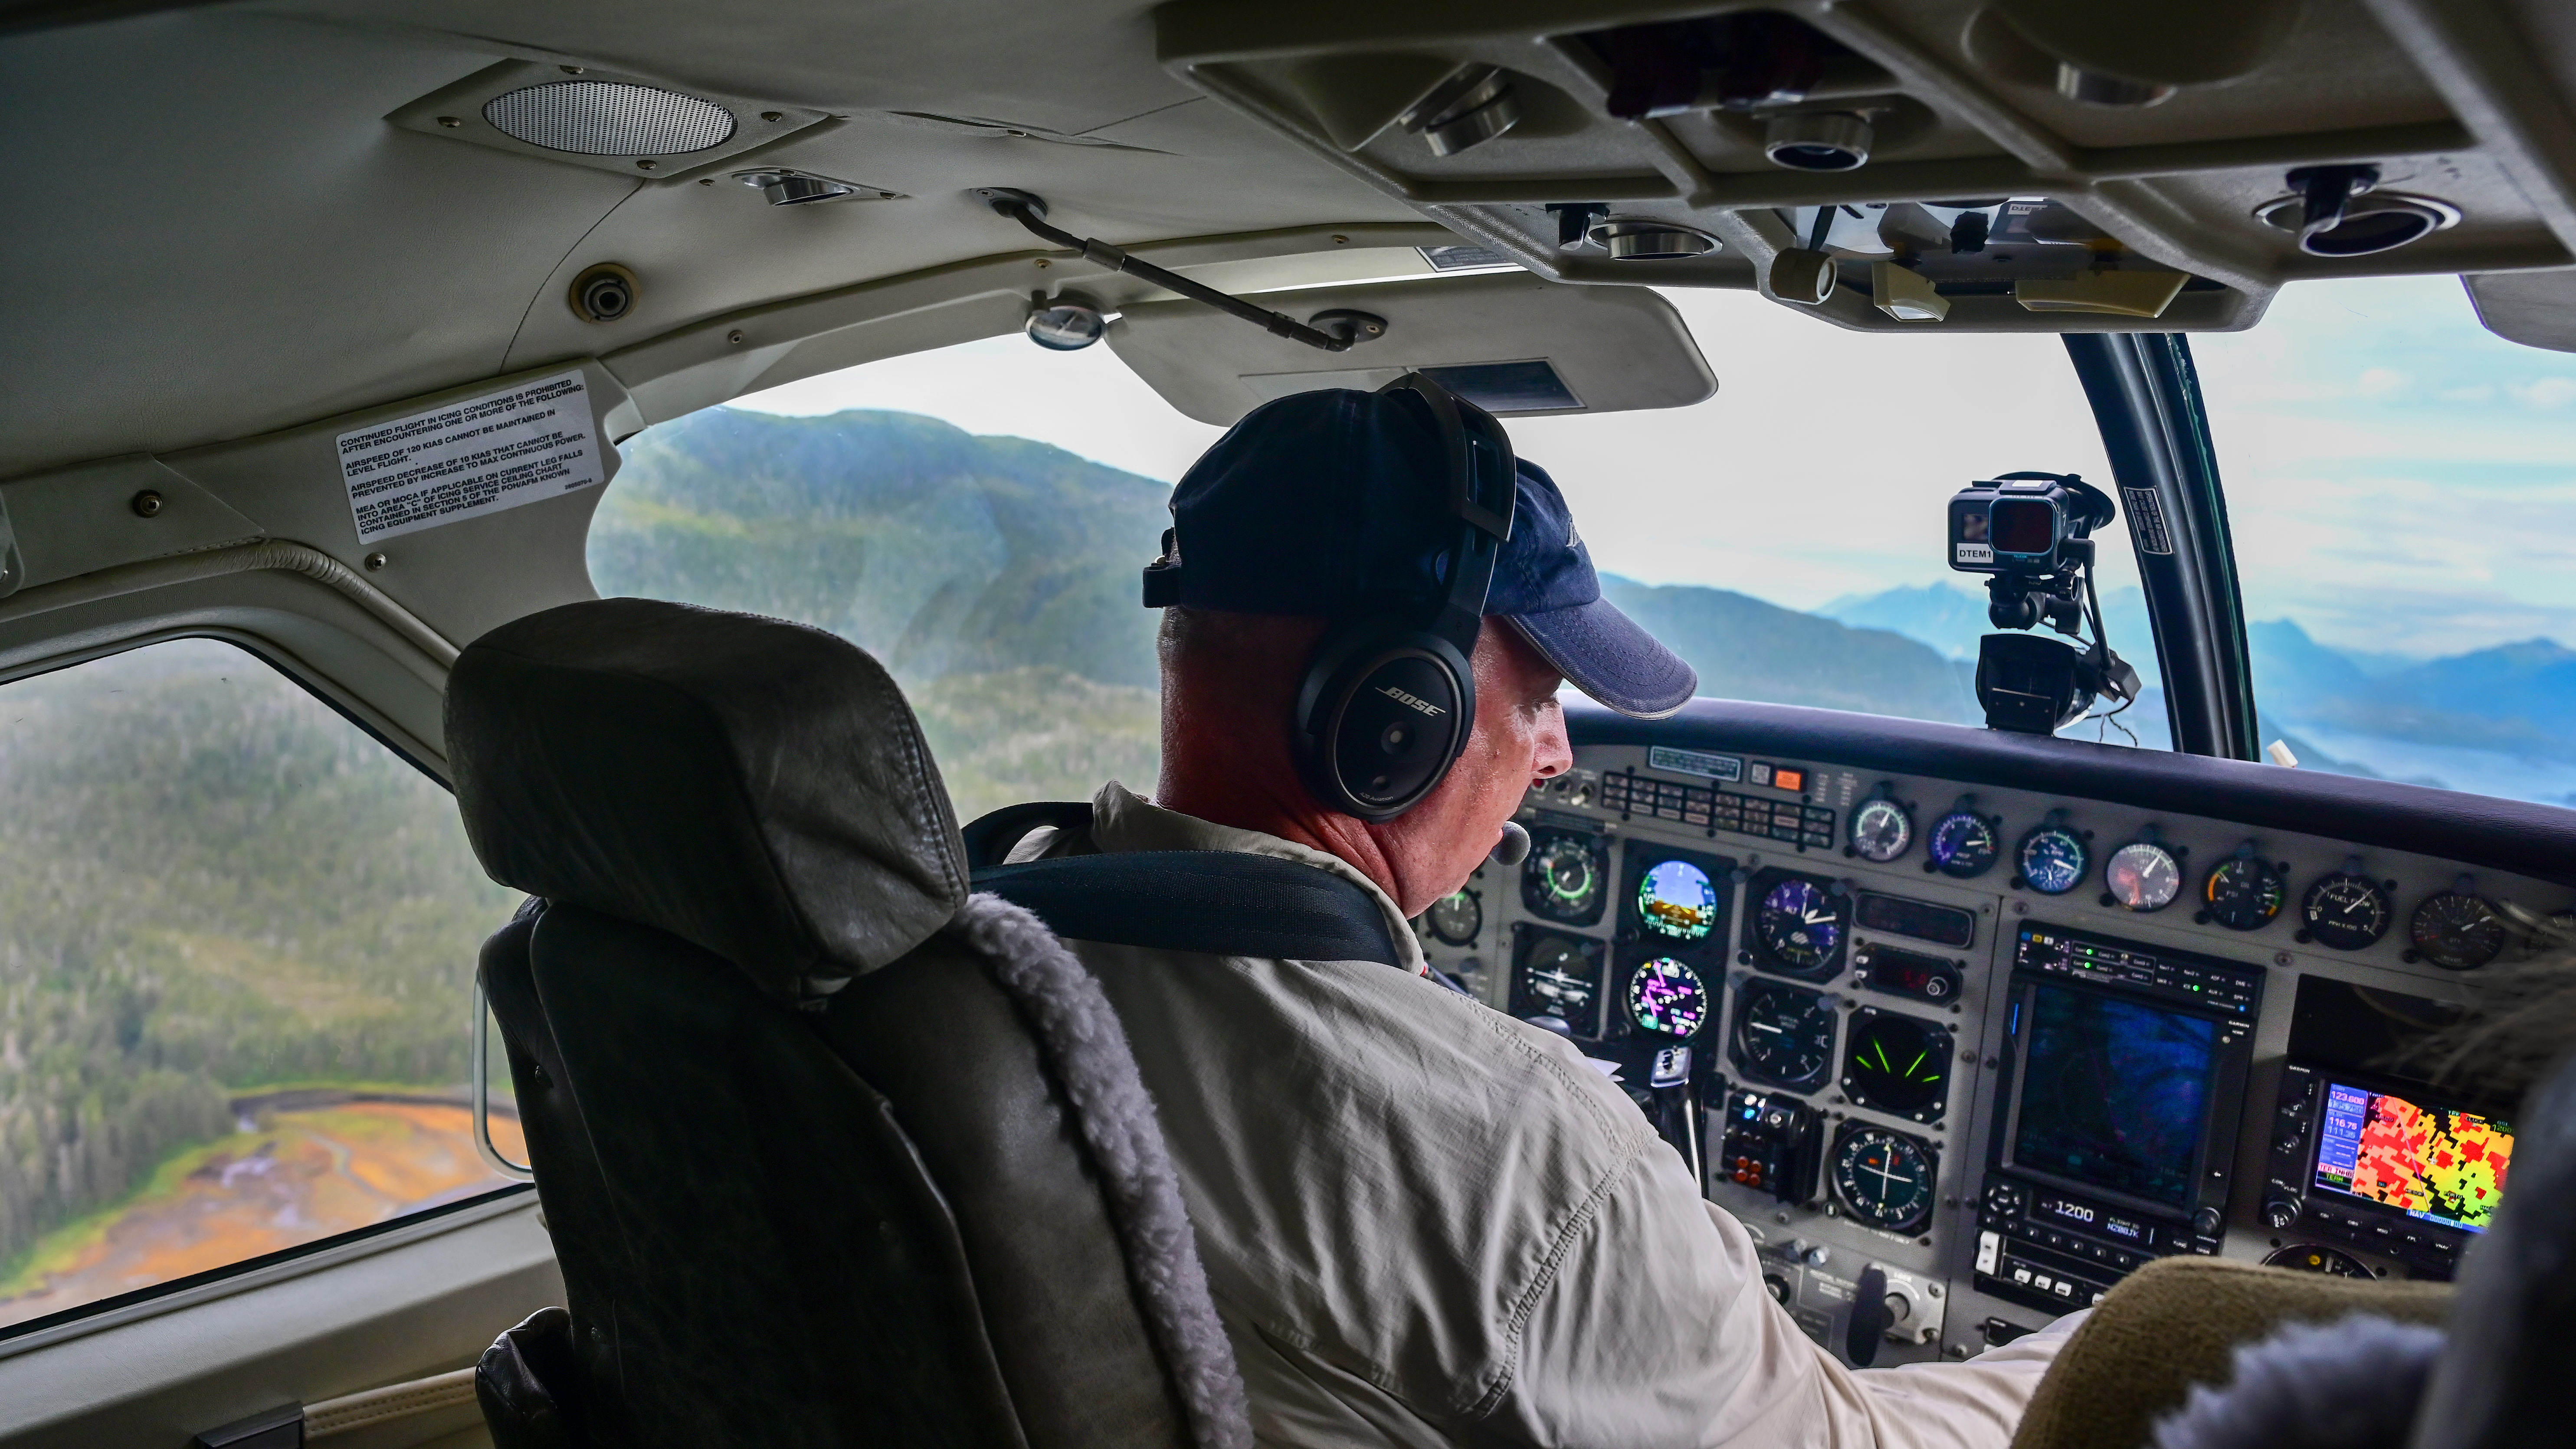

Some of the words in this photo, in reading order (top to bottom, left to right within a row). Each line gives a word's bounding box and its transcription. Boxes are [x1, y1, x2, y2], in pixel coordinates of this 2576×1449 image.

[341, 428, 392, 447] CONTINUED
[394, 419, 426, 432] FLIGHT
[438, 410, 462, 421] ICING
[463, 396, 514, 414] CONDITIONS
[525, 379, 571, 397] PROHIBITED
[342, 441, 371, 454] AFTER
[373, 422, 443, 445] ENCOUNTERING
[445, 417, 463, 426] ONE
[465, 413, 477, 421] OR
[479, 406, 504, 417] MORE
[518, 397, 534, 406] THE
[536, 384, 583, 402] FOLLOWING:
[346, 453, 390, 469] AIRSPEED
[392, 448, 403, 457] OF
[406, 445, 421, 453] 120
[423, 438, 443, 449] KIAS
[445, 428, 480, 443] CANNOT
[482, 425, 494, 433] BE
[495, 412, 545, 430] MAINTAINED
[347, 464, 376, 477] LEVEL
[377, 455, 411, 469] FLIGHT.
[351, 475, 395, 492] AIRSPEED
[397, 462, 444, 479] DECREASE
[446, 458, 457, 467] OF
[471, 450, 491, 460] KIAS
[492, 444, 514, 454] THAT
[516, 434, 550, 448] CANNOT
[551, 431, 563, 439] BE
[352, 480, 405, 499] PREVENTED
[406, 476, 418, 484] BY
[421, 464, 465, 481] INCREASE
[479, 455, 498, 466] MAX
[500, 442, 554, 460] CONTINUOUS
[555, 433, 585, 446] POWER.
[356, 504, 376, 514] MEA
[377, 499, 390, 508] OR
[392, 492, 419, 504] MOCA
[430, 475, 484, 494] APPLICABLE
[485, 472, 498, 480] ON
[500, 461, 539, 476] CURRENT
[541, 457, 557, 466] LEG
[558, 449, 583, 461] FALLS
[357, 510, 378, 520] INTO
[381, 504, 405, 515] AREA
[423, 495, 436, 503] OF
[437, 489, 461, 500] ICING
[462, 479, 499, 493] SERVICE
[501, 471, 534, 484] CEILING
[535, 462, 562, 475] CHART
[360, 509, 410, 527] CONTAINED
[423, 496, 460, 511] SECTION
[469, 491, 480, 499] OF
[482, 487, 499, 496] THE
[501, 477, 538, 491] POH/AFM
[540, 468, 570, 481] KNOWN
[361, 523, 385, 534] ICING
[387, 510, 437, 527] EQUIPMENT
[439, 495, 498, 514] SUPPLEMENT.
[1959, 550, 1991, 558] DTEM1
[1375, 687, 1446, 716] BOSE
[2055, 1200, 2094, 1222] 1200
[2409, 1209, 2425, 1219] NAV
